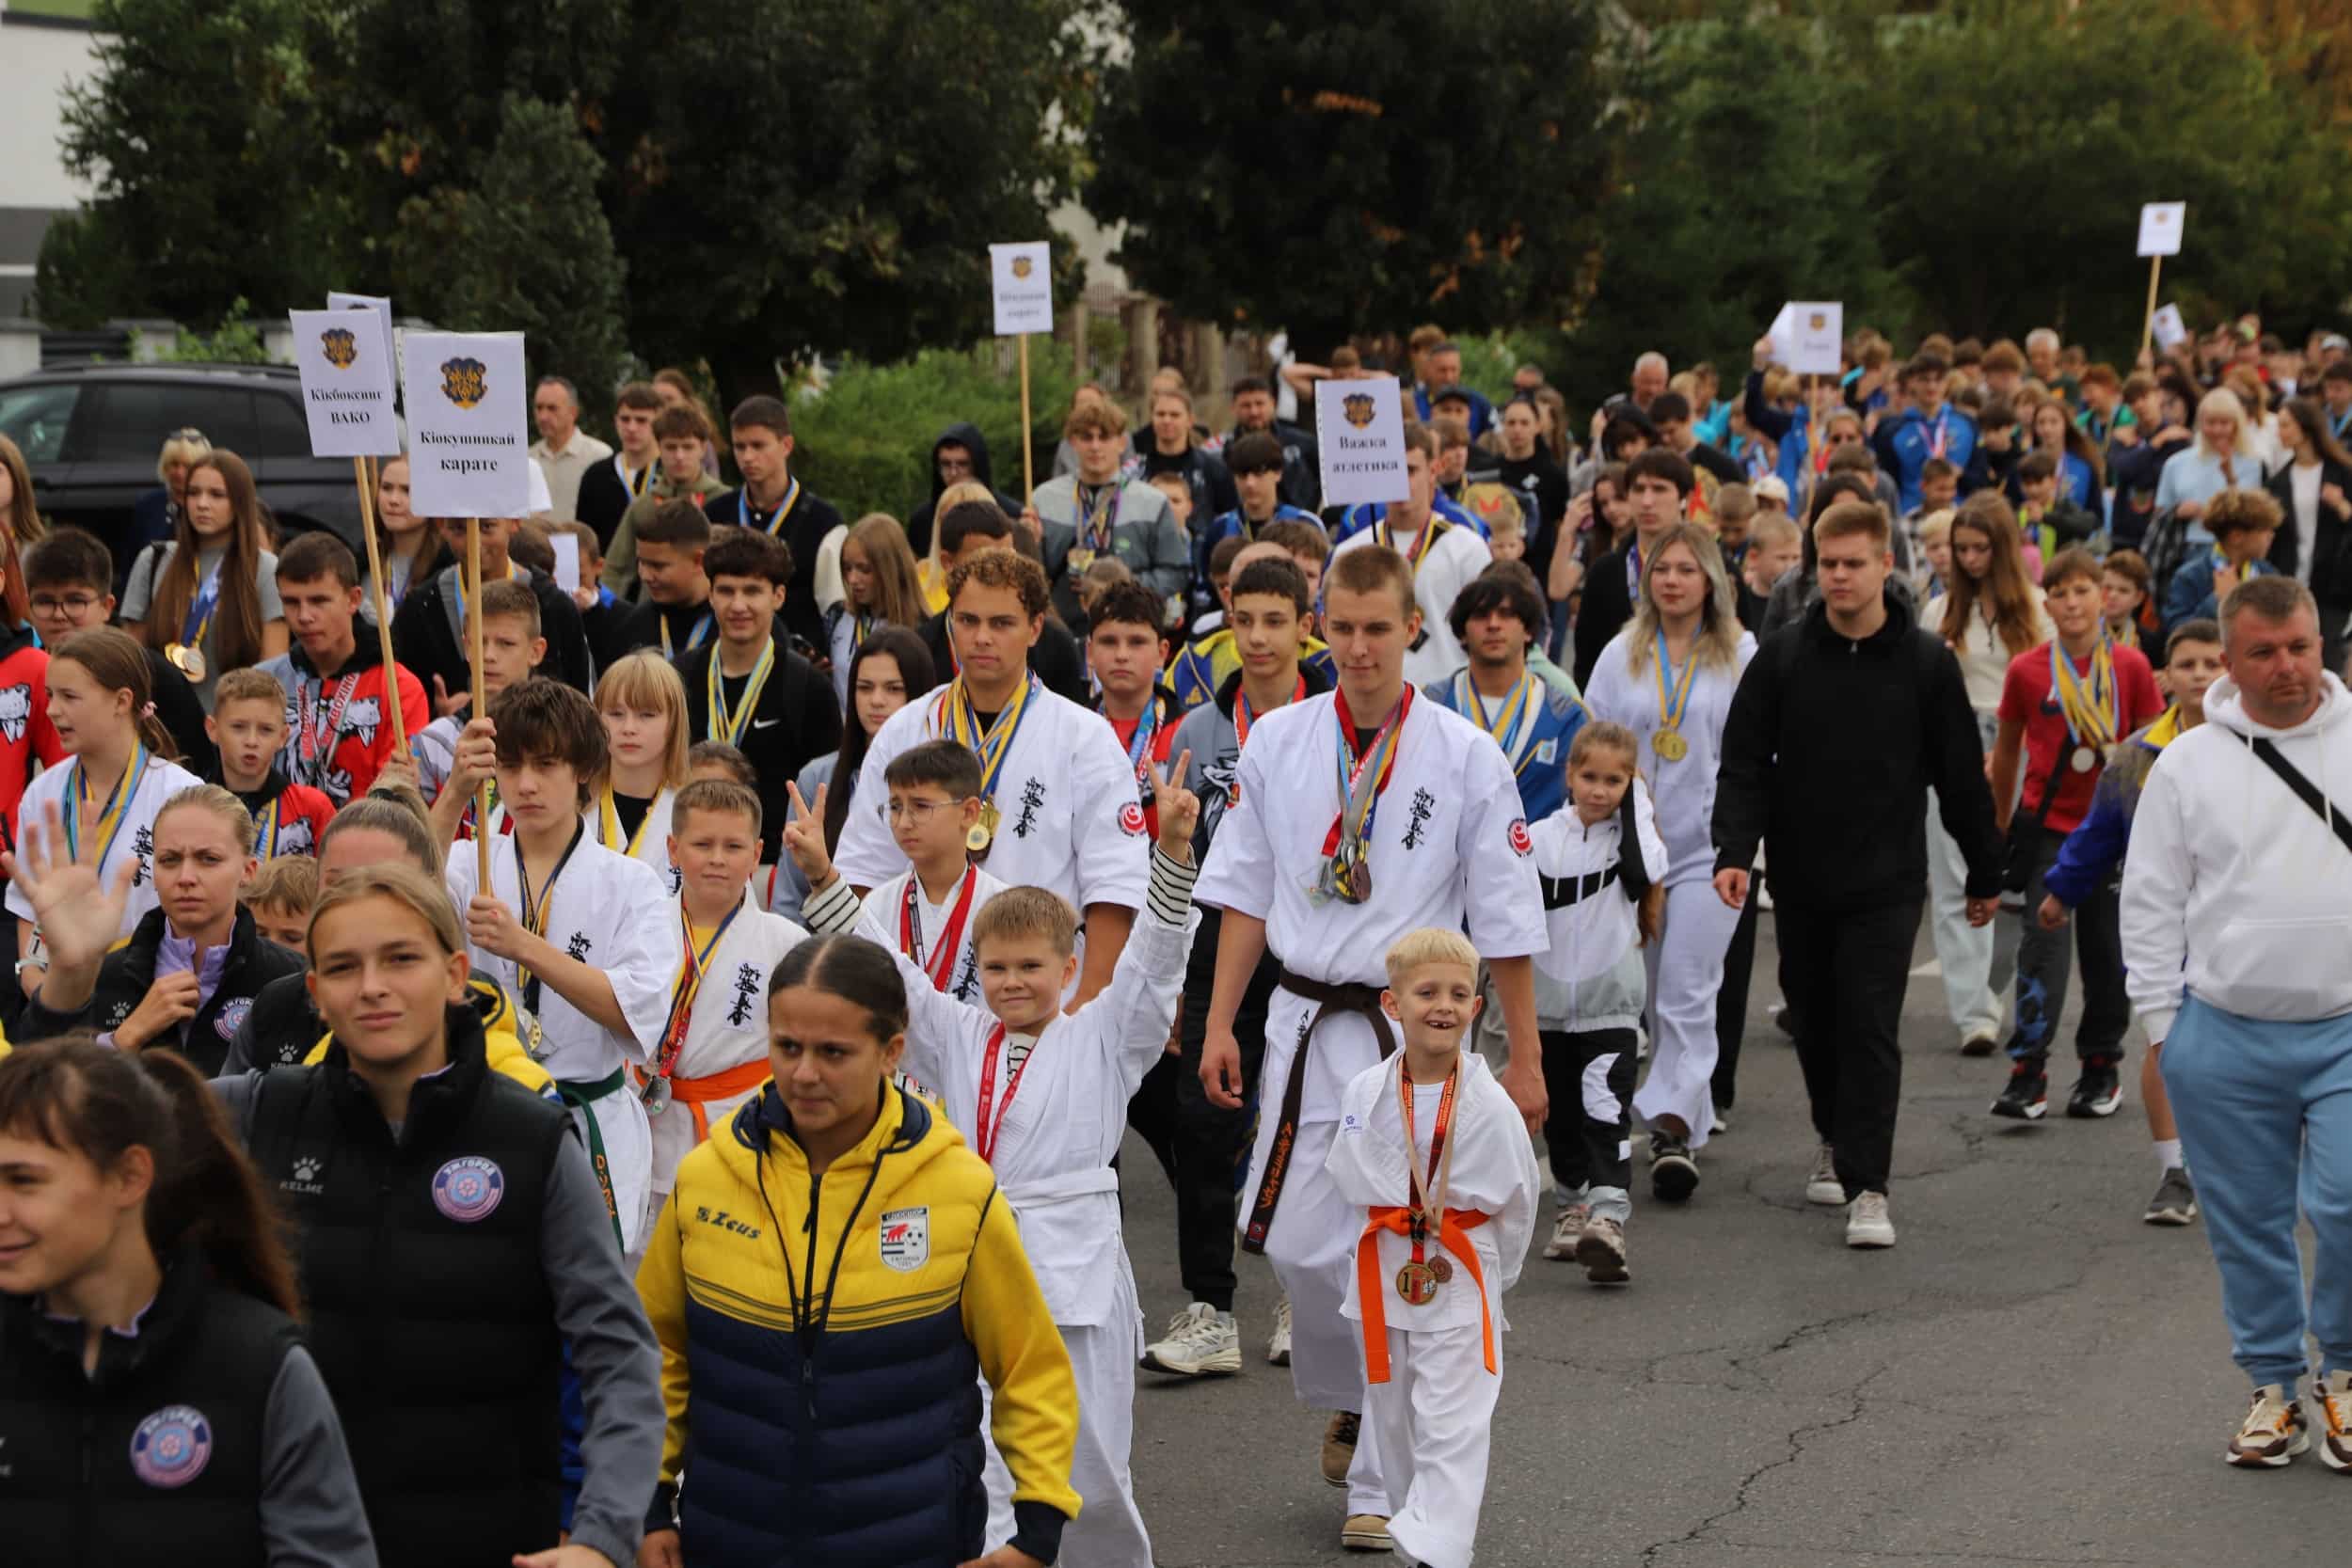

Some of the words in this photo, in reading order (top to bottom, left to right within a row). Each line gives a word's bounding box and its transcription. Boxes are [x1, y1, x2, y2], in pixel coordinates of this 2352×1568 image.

[310, 388, 383, 402] Кікбоксинг
[330, 411, 371, 424] ВАКО
[421, 431, 516, 448] Кіокушинкай
[1340, 436, 1387, 449] Важка
[440, 458, 498, 475] карате
[1333, 460, 1399, 473] атлетика
[710, 1211, 762, 1239] Zeus
